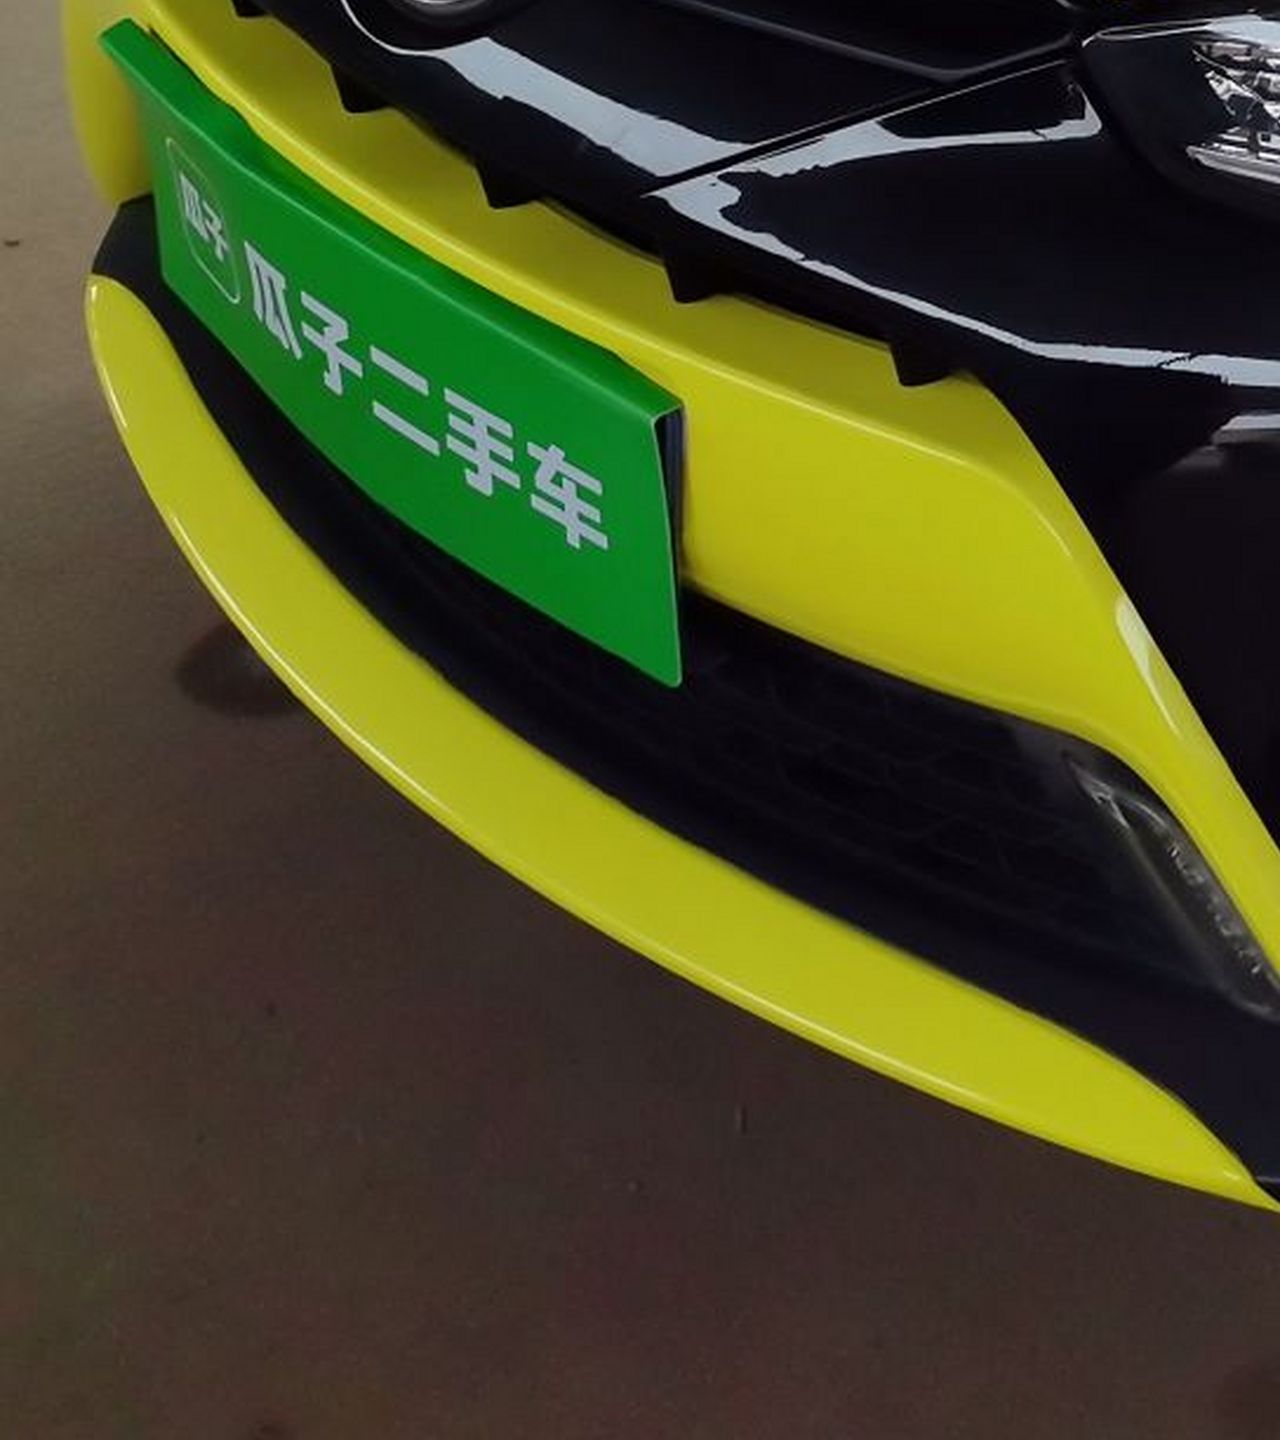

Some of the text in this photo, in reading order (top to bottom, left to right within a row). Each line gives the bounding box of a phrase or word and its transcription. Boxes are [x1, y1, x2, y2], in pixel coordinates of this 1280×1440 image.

[179, 173, 230, 262] 瓜子
[244, 240, 608, 551] 瓜子二手车
